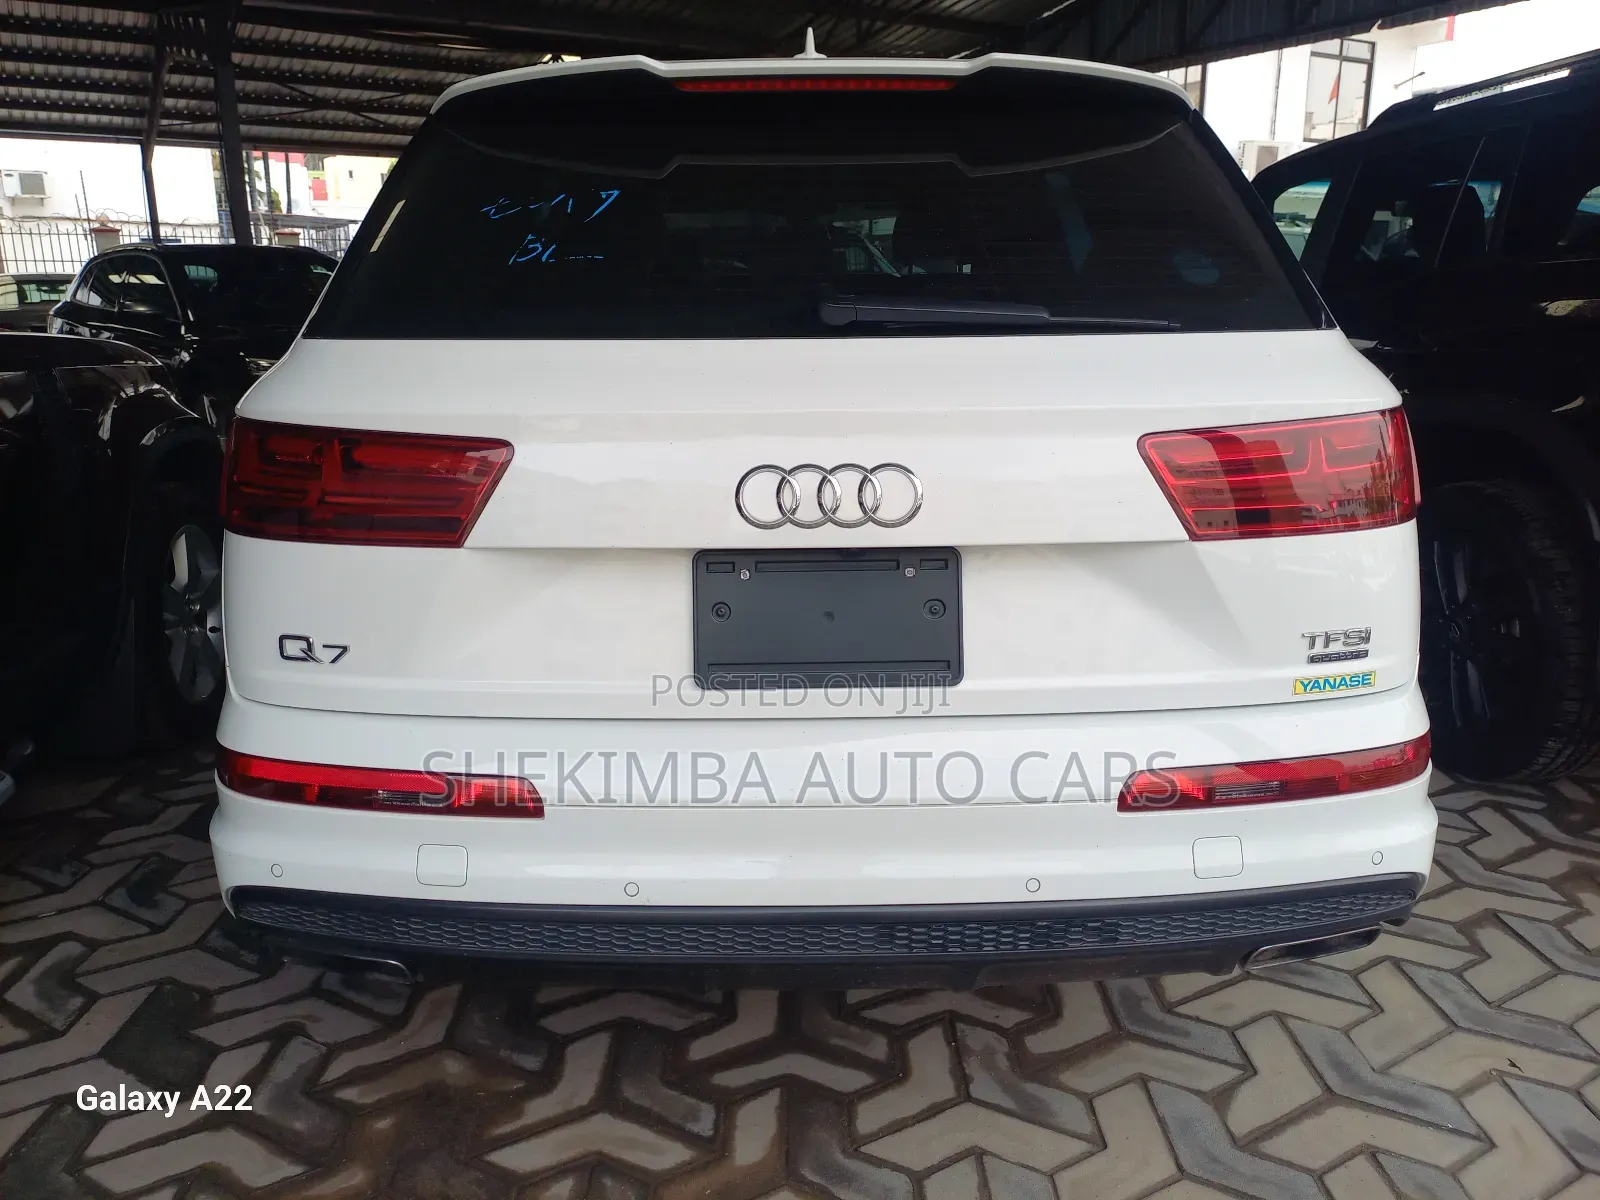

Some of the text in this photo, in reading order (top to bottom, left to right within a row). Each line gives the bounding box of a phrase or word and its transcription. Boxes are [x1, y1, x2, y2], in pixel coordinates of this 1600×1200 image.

[279, 633, 350, 664] Q7
[1301, 627, 1371, 649] TFSI
[1299, 673, 1373, 692] YANASE
